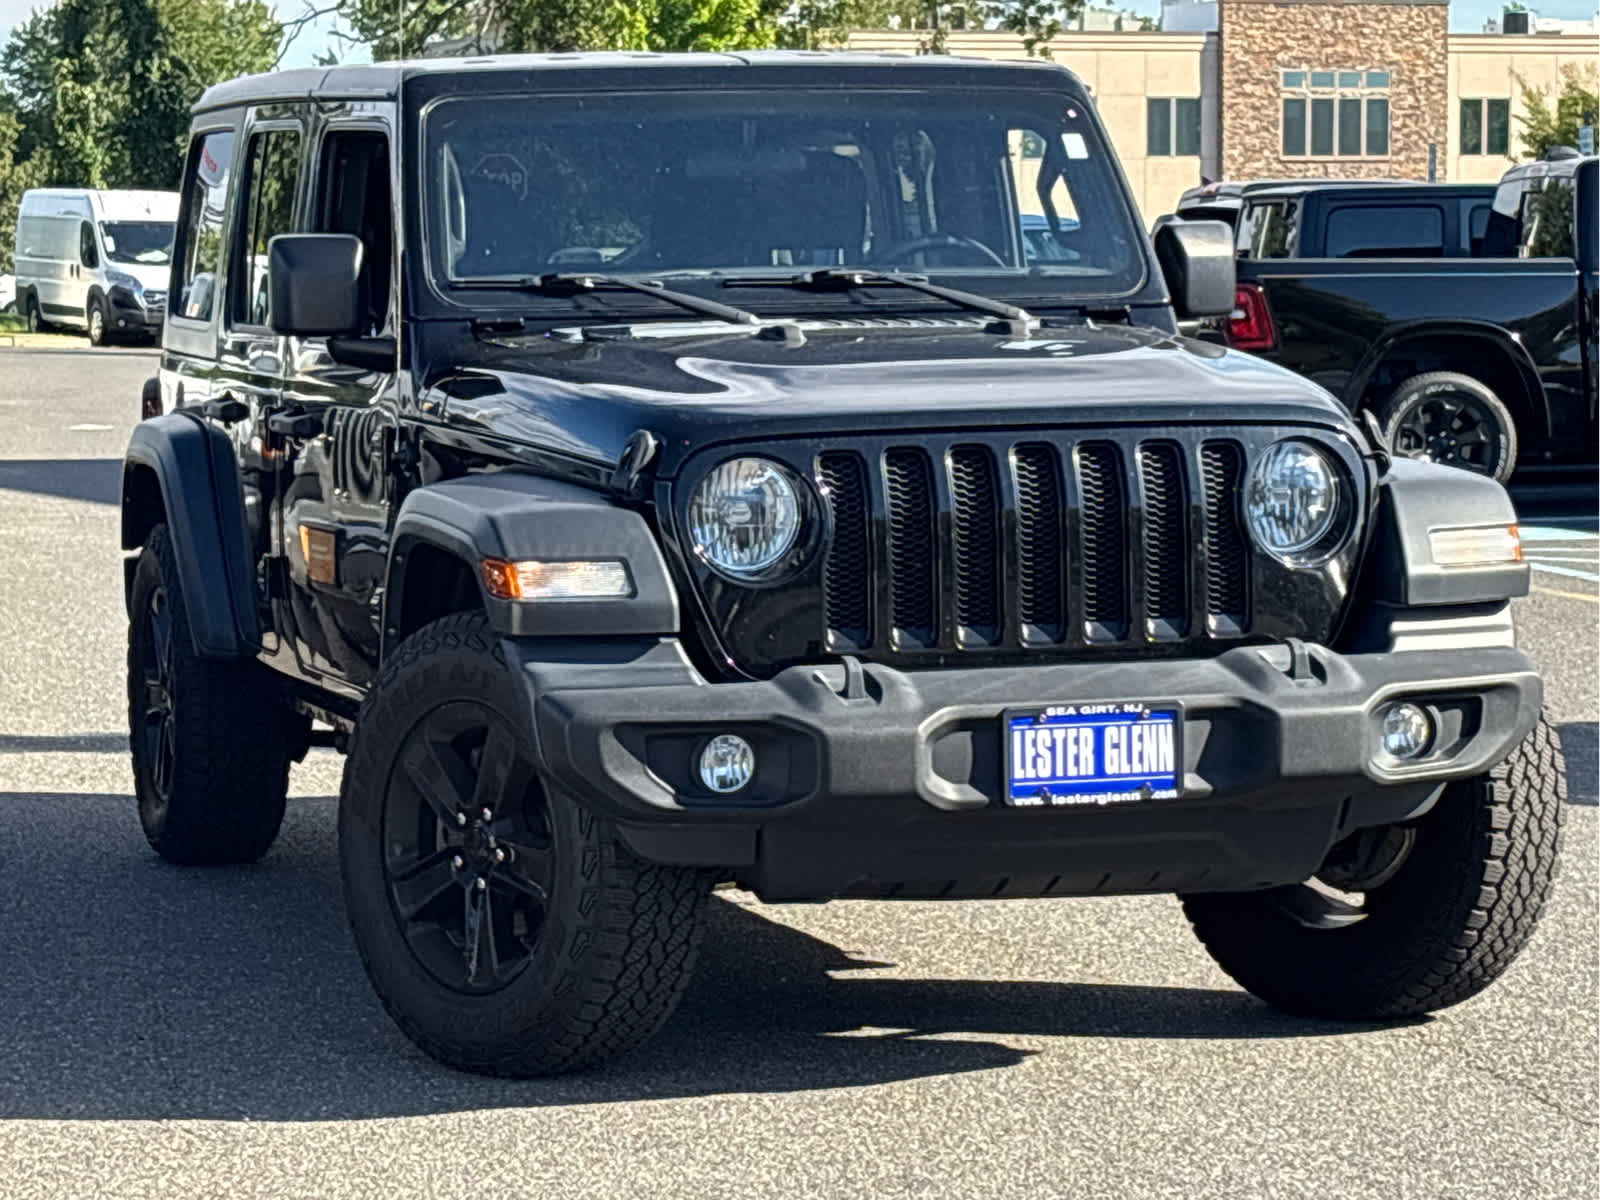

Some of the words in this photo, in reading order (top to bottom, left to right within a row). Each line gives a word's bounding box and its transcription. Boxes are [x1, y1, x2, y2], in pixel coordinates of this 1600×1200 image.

[1046, 706, 1076, 716] SEA
[1080, 704, 1120, 715] GIRT,
[1123, 703, 1143, 713] NJ
[1013, 727, 1095, 779] LESTER
[1103, 723, 1175, 775] GLENN
[1051, 791, 1141, 806] lesterglenn
